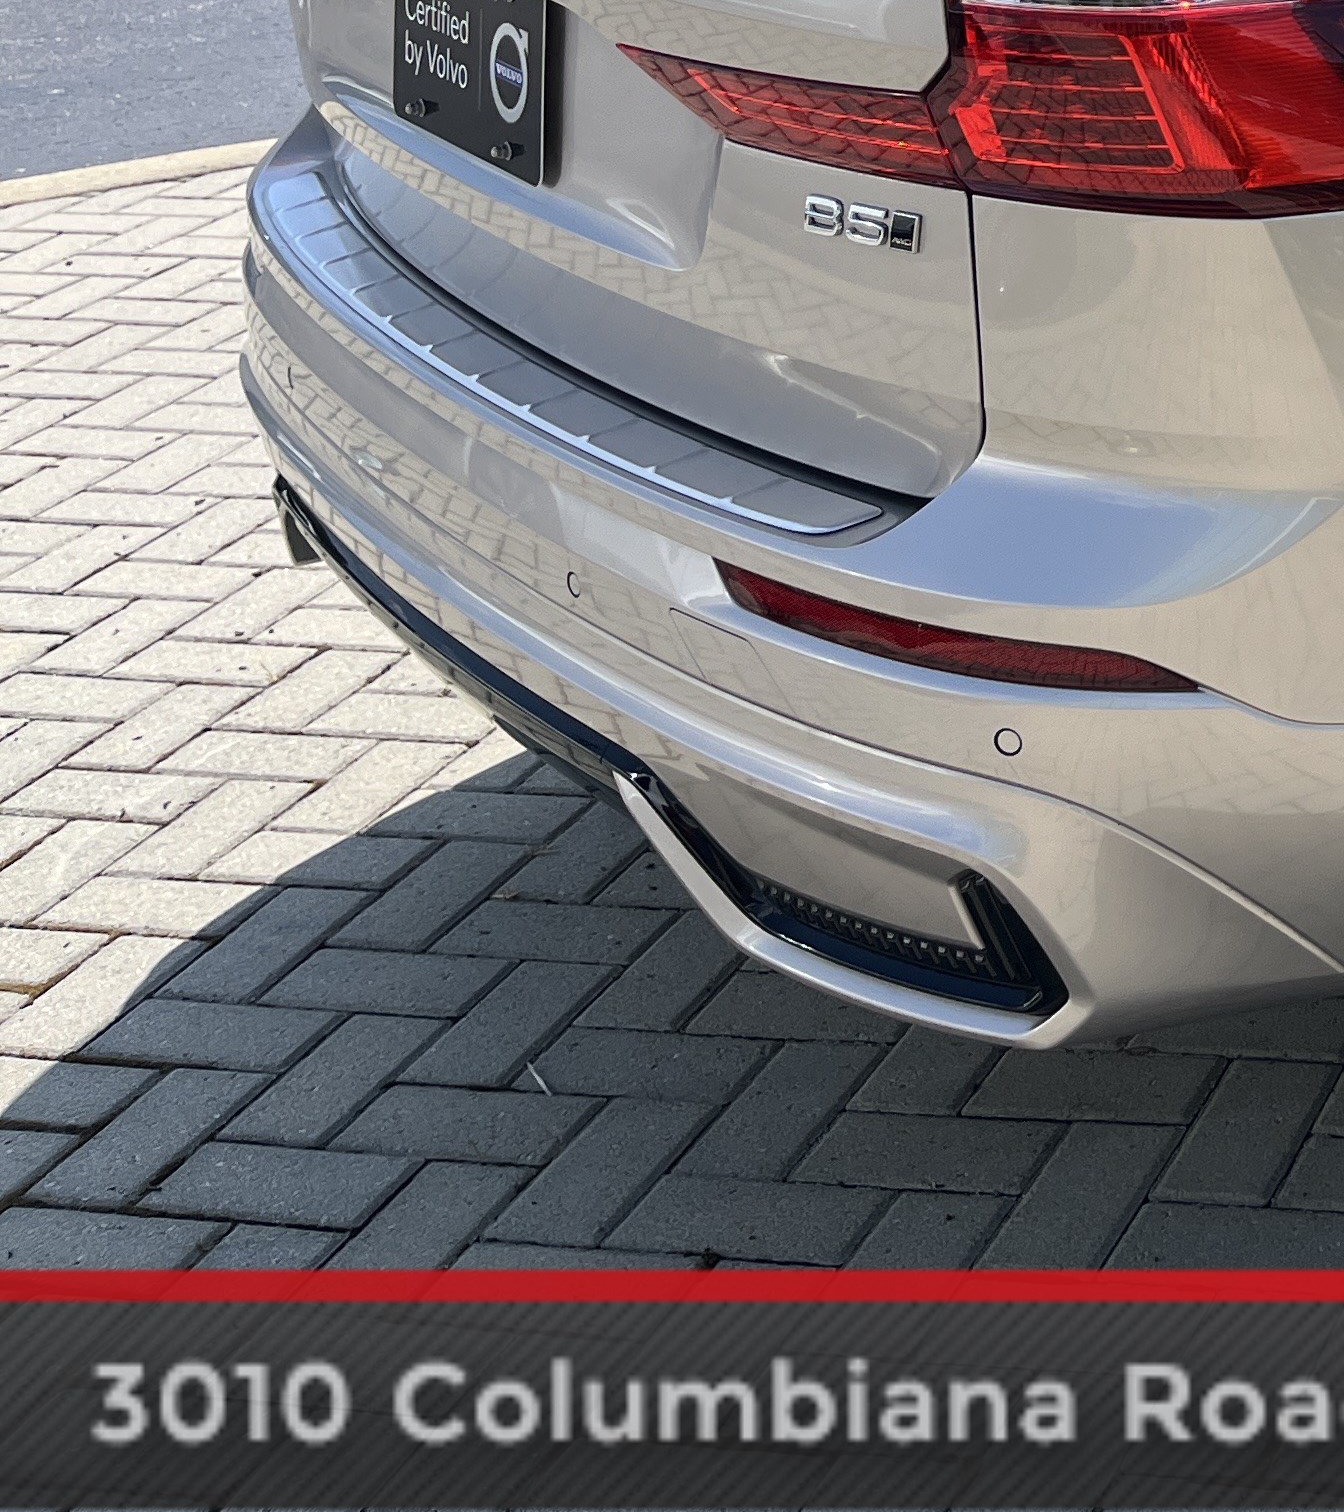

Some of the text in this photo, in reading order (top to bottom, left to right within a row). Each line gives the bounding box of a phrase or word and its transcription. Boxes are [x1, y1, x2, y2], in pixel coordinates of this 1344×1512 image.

[405, 29, 468, 89] by Volvo
[495, 61, 523, 85] VOLVO
[804, 194, 888, 246] B5
